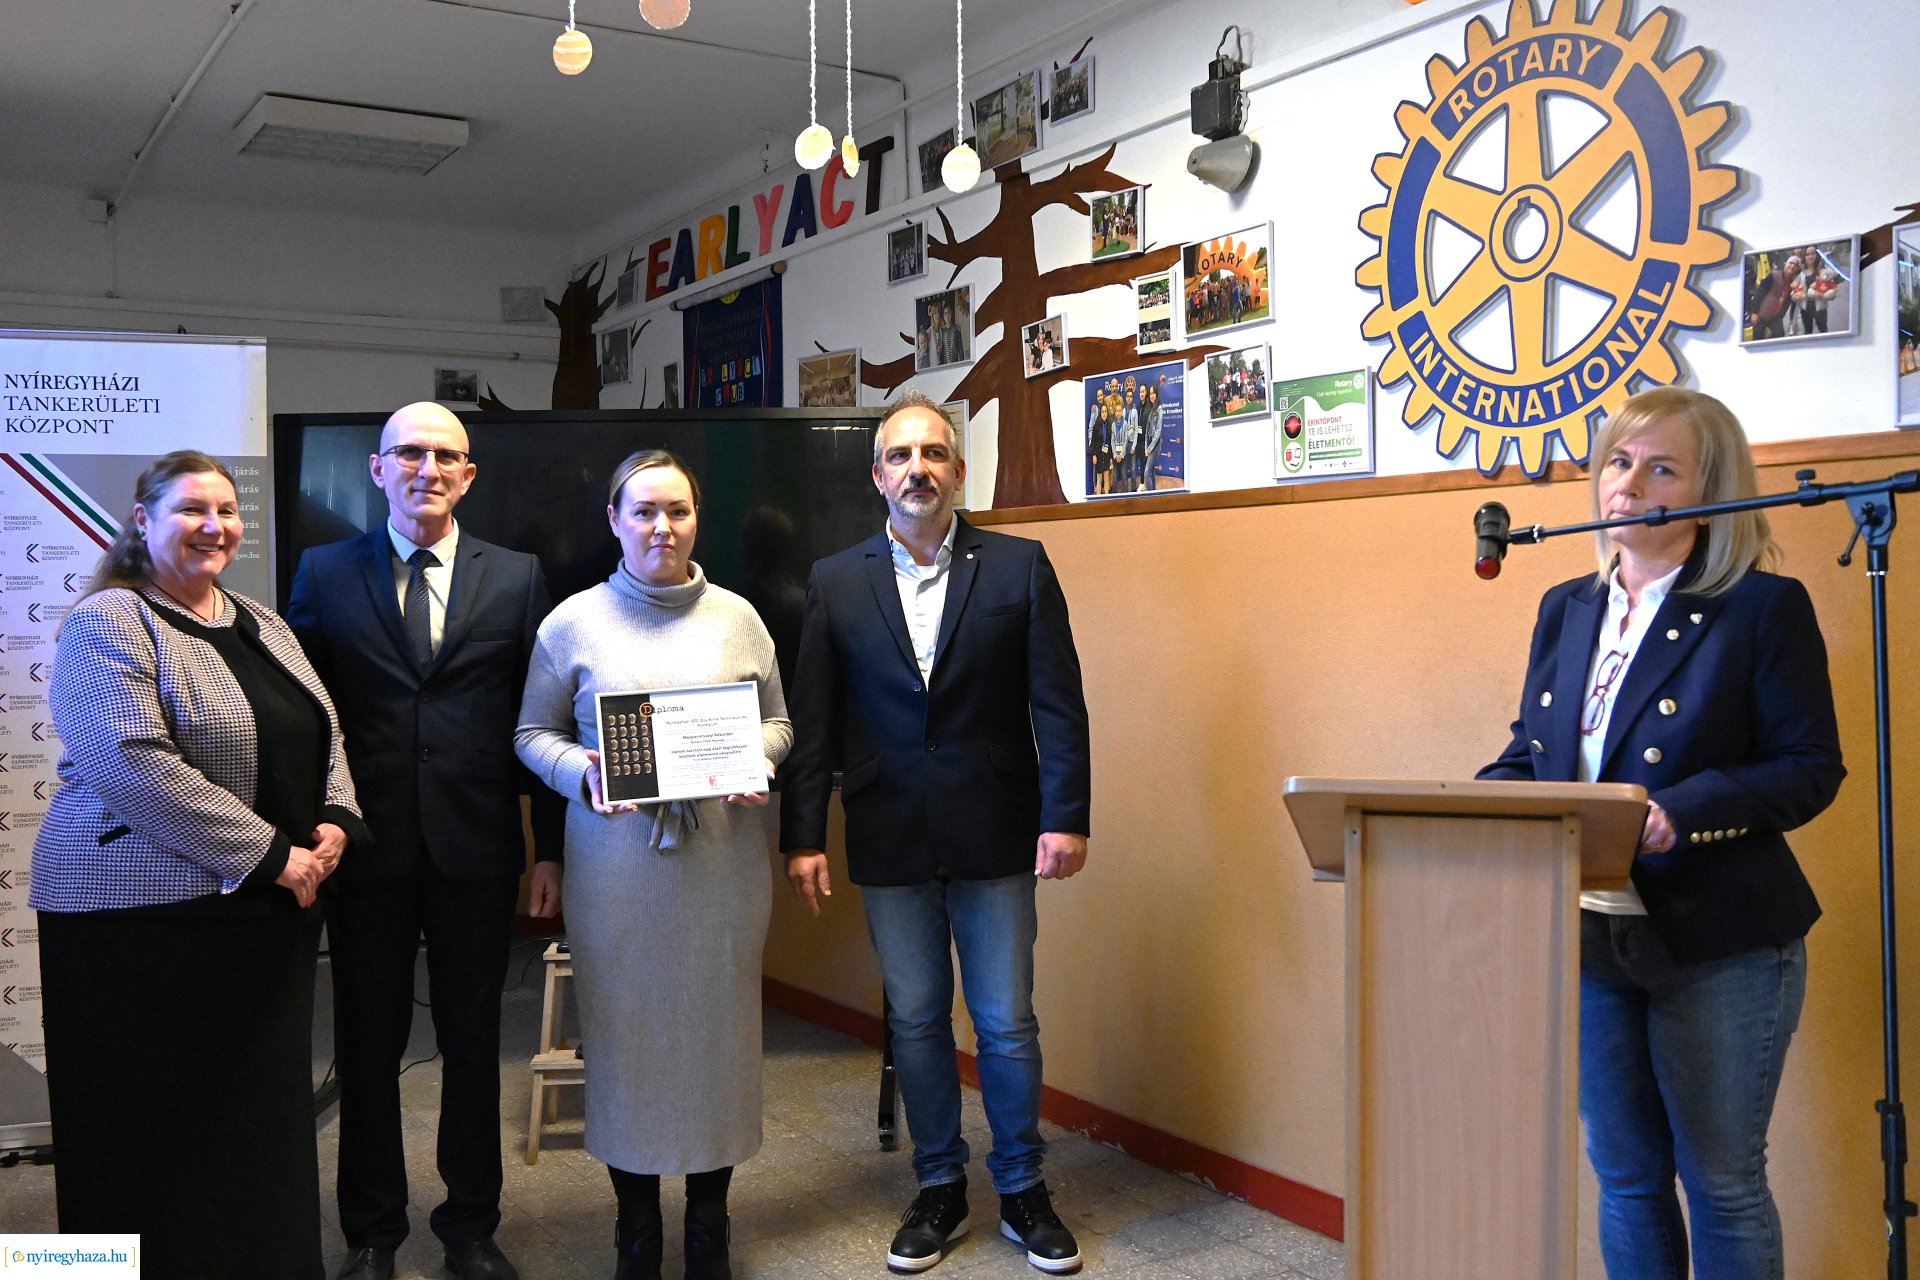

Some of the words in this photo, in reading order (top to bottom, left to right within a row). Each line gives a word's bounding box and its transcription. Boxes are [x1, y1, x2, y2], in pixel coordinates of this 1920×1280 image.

[1450, 38, 1603, 123] ROTARY
[645, 135, 894, 302] EARLYACT
[1408, 280, 1671, 424] INTERNATIONAL
[4, 371, 140, 392] NYÍREGYHÁZI
[1105, 382, 1123, 391] Rory
[4, 395, 160, 414] TANKERÜLETI
[5, 416, 114, 434] KÖZPONT
[1325, 423, 1353, 434] LEHETSZ
[1308, 435, 1355, 450] ÉLETMENTŐ!
[234, 466, 259, 478] járás
[236, 484, 259, 493] árás
[239, 502, 260, 511] árás
[641, 703, 684, 716] Diploma
